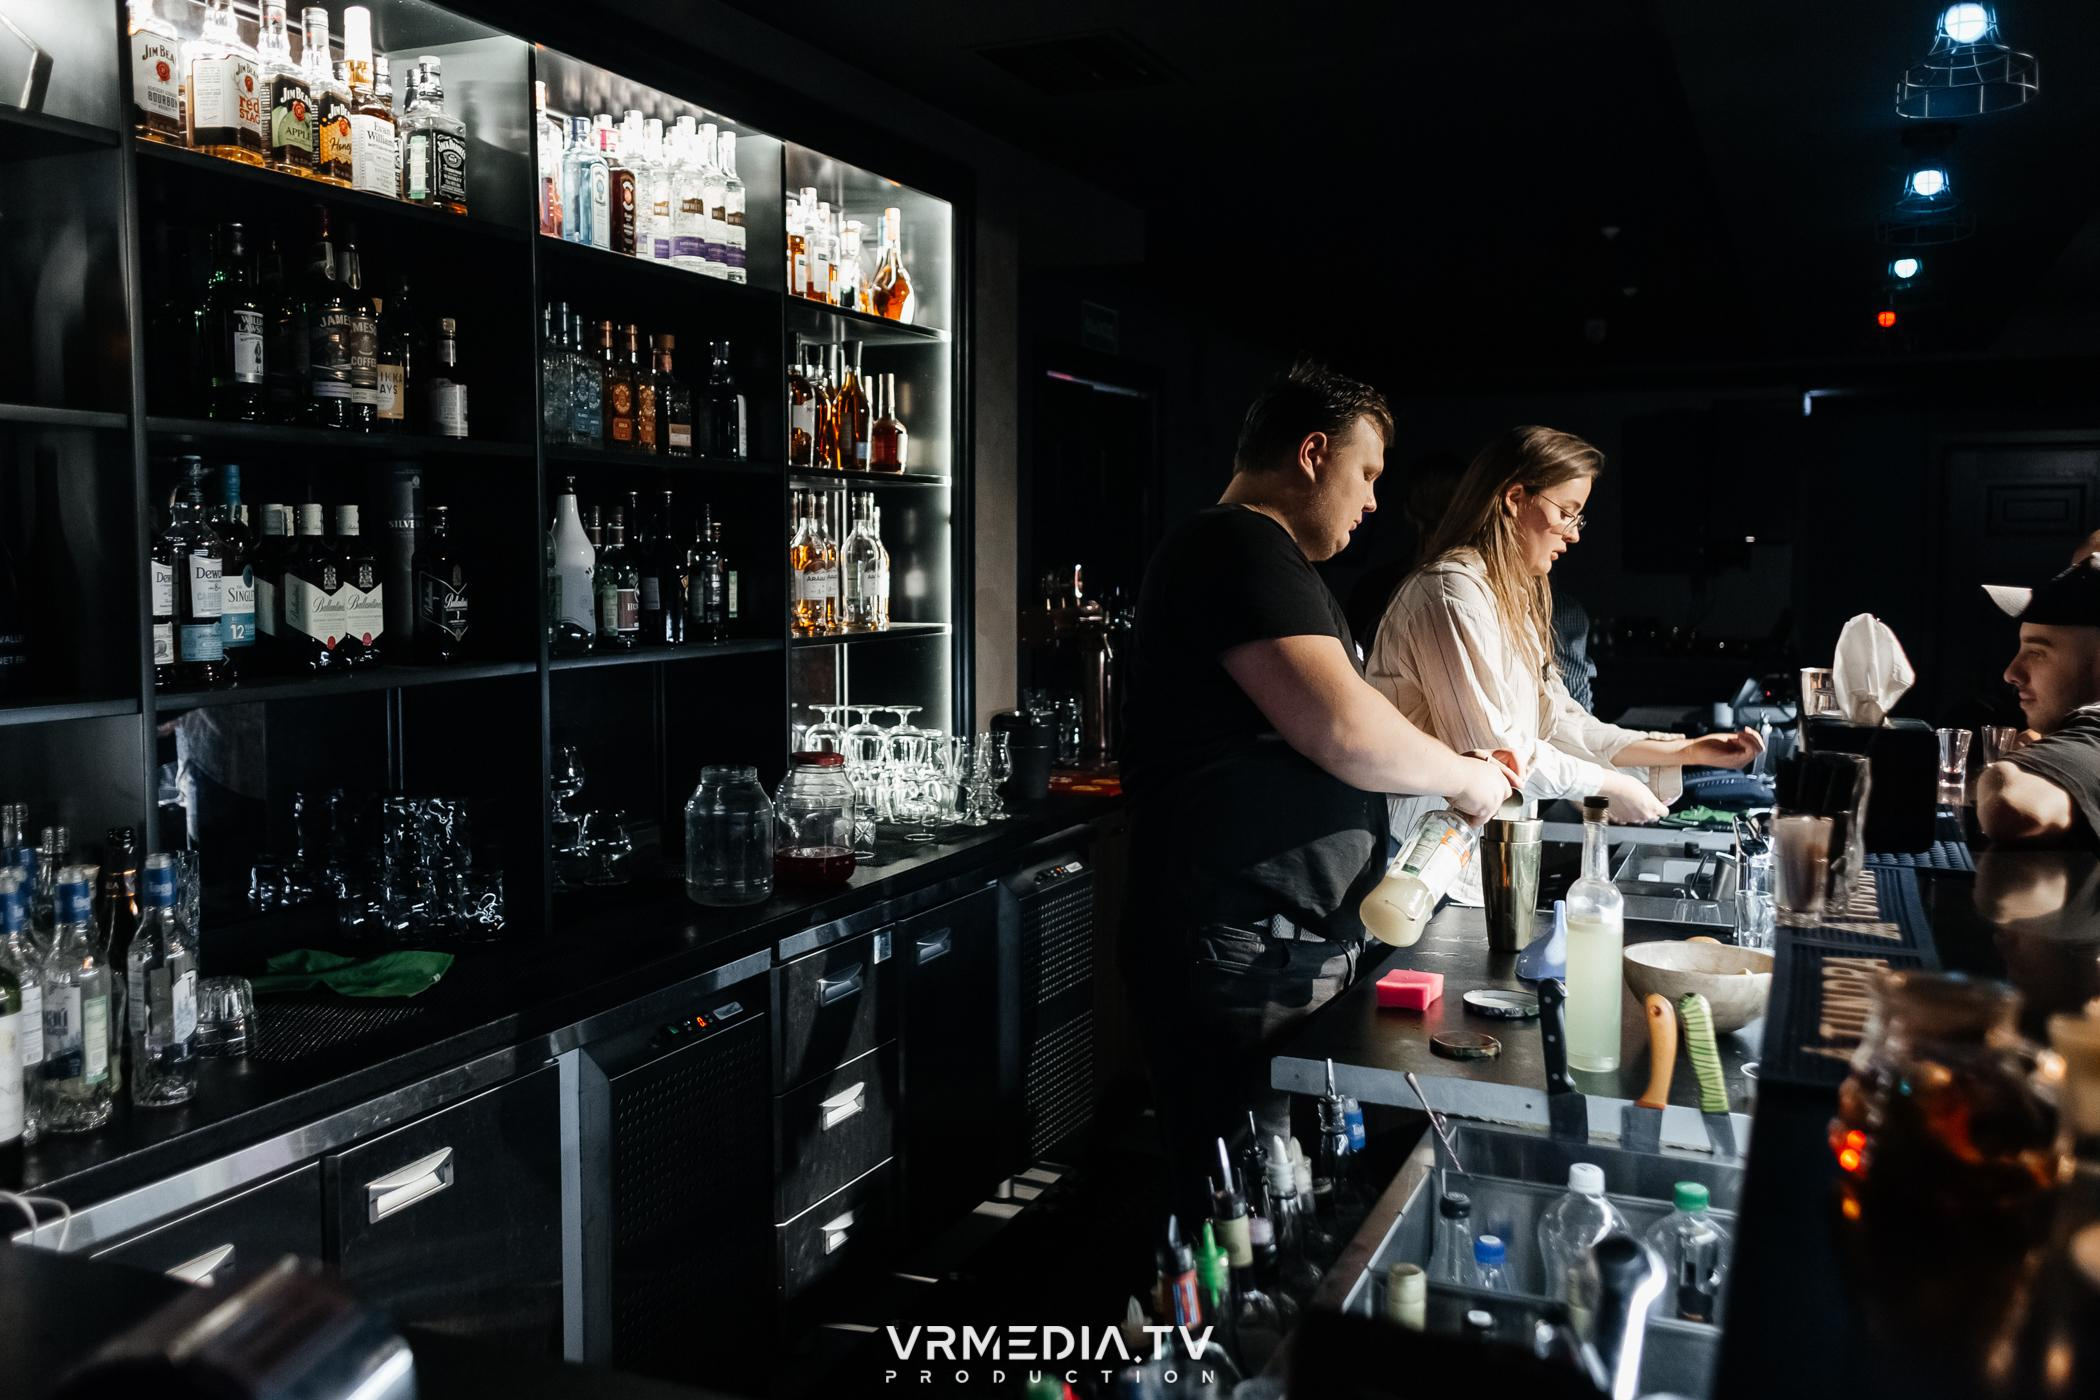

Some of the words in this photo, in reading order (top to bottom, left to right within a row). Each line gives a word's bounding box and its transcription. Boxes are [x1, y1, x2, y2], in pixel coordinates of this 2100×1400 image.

[142, 44, 159, 61] JIM
[159, 44, 177, 65] BEA
[235, 63, 248, 76] JIM
[280, 86, 297, 103] JIM
[239, 96, 260, 113] red
[328, 103, 342, 119] JIM
[373, 121, 391, 136] Evan
[367, 130, 395, 148] William
[238, 322, 263, 334] LAWSO
[379, 384, 398, 395] AYS
[227, 587, 254, 603] SINGL
[230, 624, 245, 640] 12
